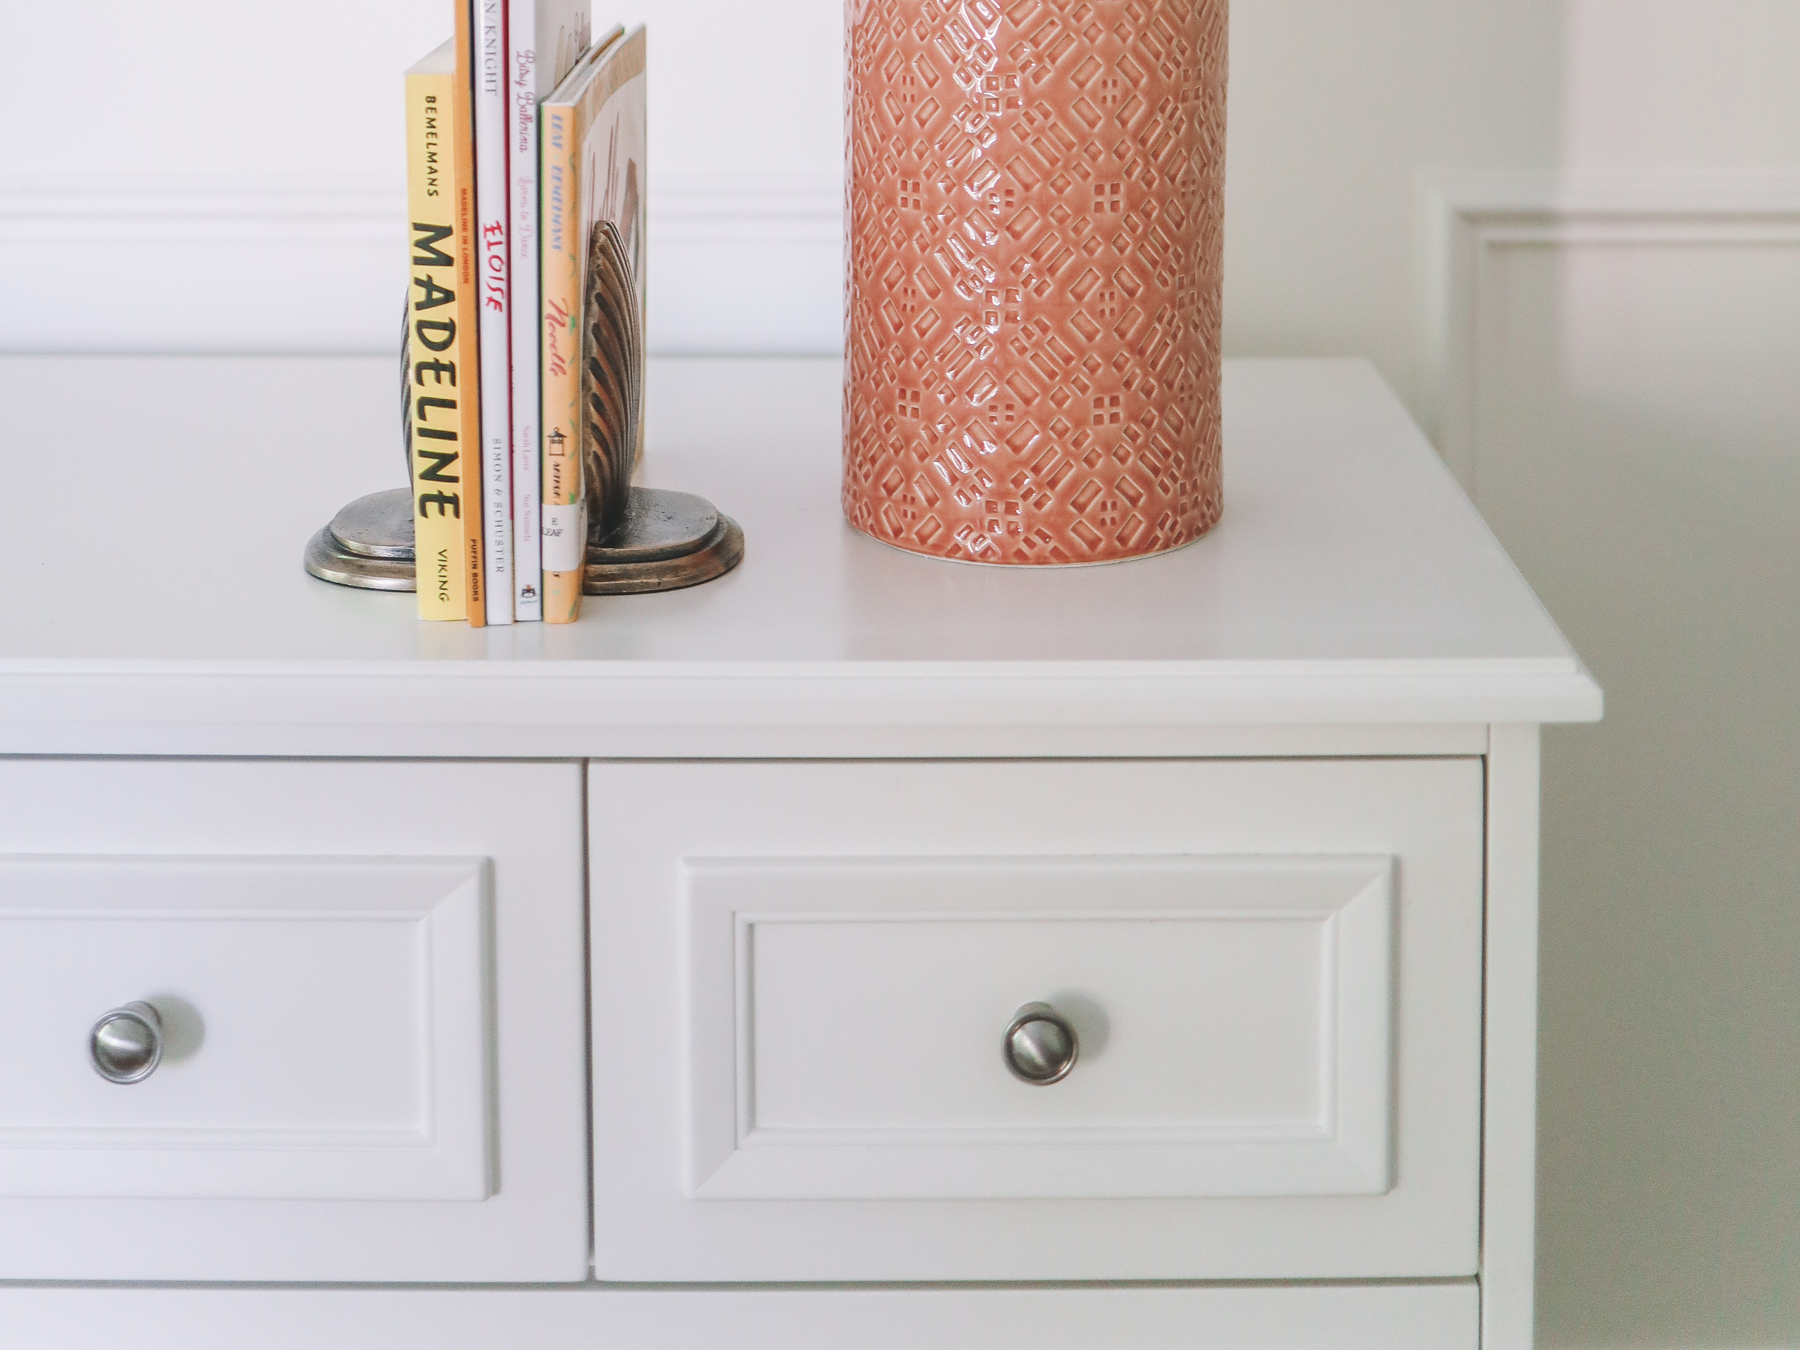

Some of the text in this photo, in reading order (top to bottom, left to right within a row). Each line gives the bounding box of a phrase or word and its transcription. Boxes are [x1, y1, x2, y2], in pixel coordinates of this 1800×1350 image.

[514, 49, 536, 88] Bitsy
[424, 95, 439, 197] BEMELMANS
[517, 91, 536, 154] Ballerina
[550, 114, 563, 251] LEAF BEMELMANS
[460, 188, 470, 284] MADELINE IN LONDON
[483, 220, 505, 313] ELOISE
[519, 224, 533, 259] Dance
[544, 297, 569, 377] Noodle
[411, 221, 460, 519] MADELINE
[492, 438, 502, 482] SIMON
[522, 425, 531, 447] Sarah
[494, 502, 504, 574] SCHUSTER
[551, 517, 558, 526] E
[436, 548, 450, 603] VIKING
[470, 538, 479, 602] PUFFIN BOOKS
